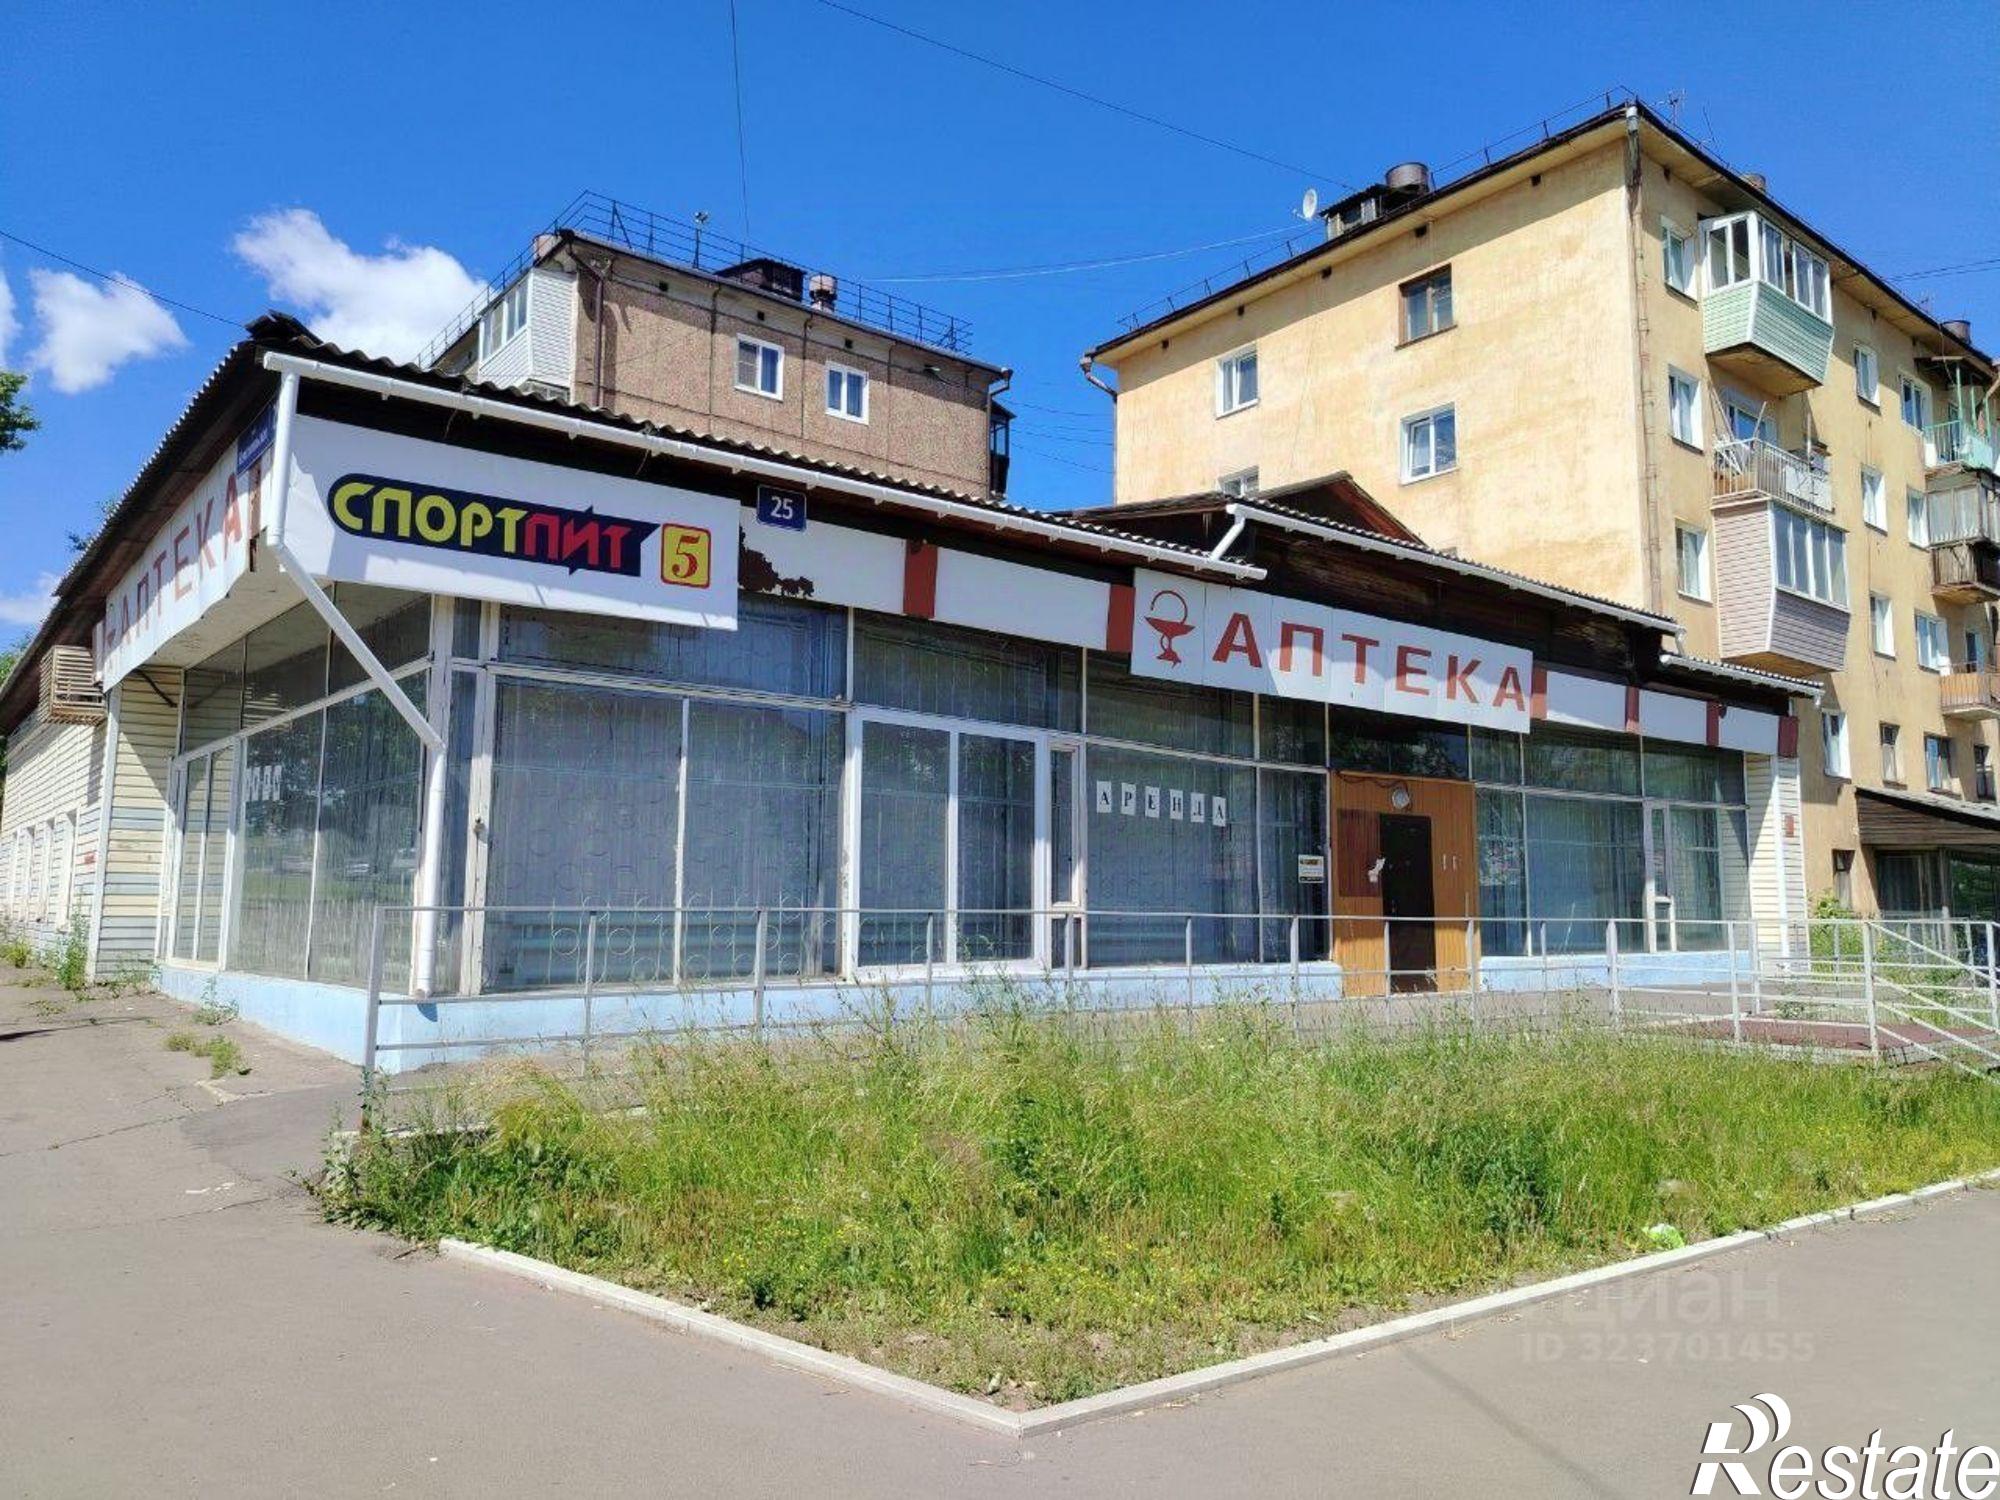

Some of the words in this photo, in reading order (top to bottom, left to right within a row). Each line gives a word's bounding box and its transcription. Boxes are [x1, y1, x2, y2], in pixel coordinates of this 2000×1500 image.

[333, 482, 632, 569] СПОРТПИТ
[769, 496, 794, 521] 25
[120, 473, 242, 639] АПТЕКА
[671, 535, 701, 579] 5
[1212, 612, 1528, 713] АПТЕКА
